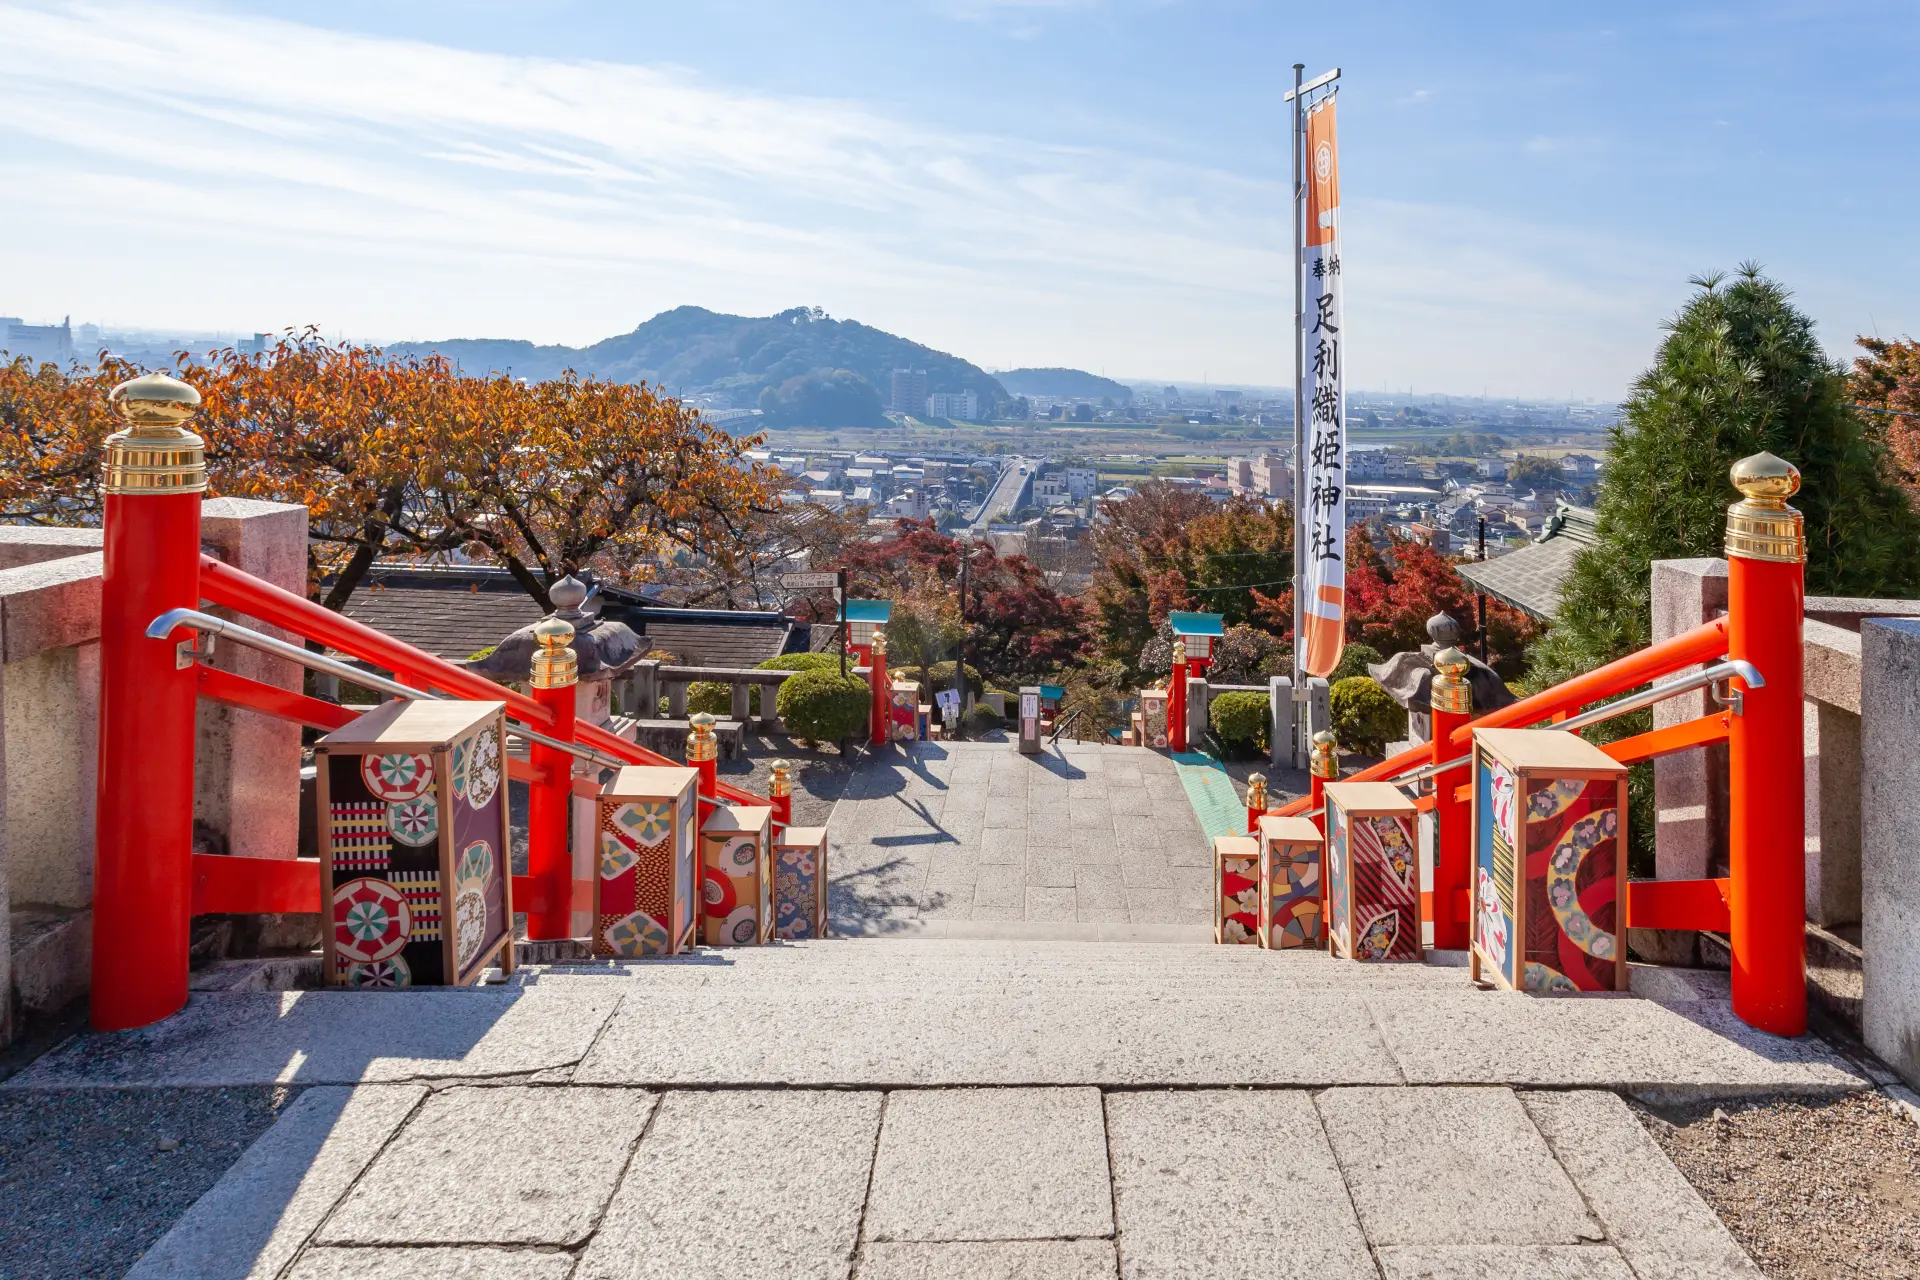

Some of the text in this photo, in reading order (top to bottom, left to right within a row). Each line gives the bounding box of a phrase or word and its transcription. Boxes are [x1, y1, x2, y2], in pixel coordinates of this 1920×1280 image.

[1312, 254, 1340, 281] 奉納
[1311, 293, 1341, 561] 足利織姫神社
